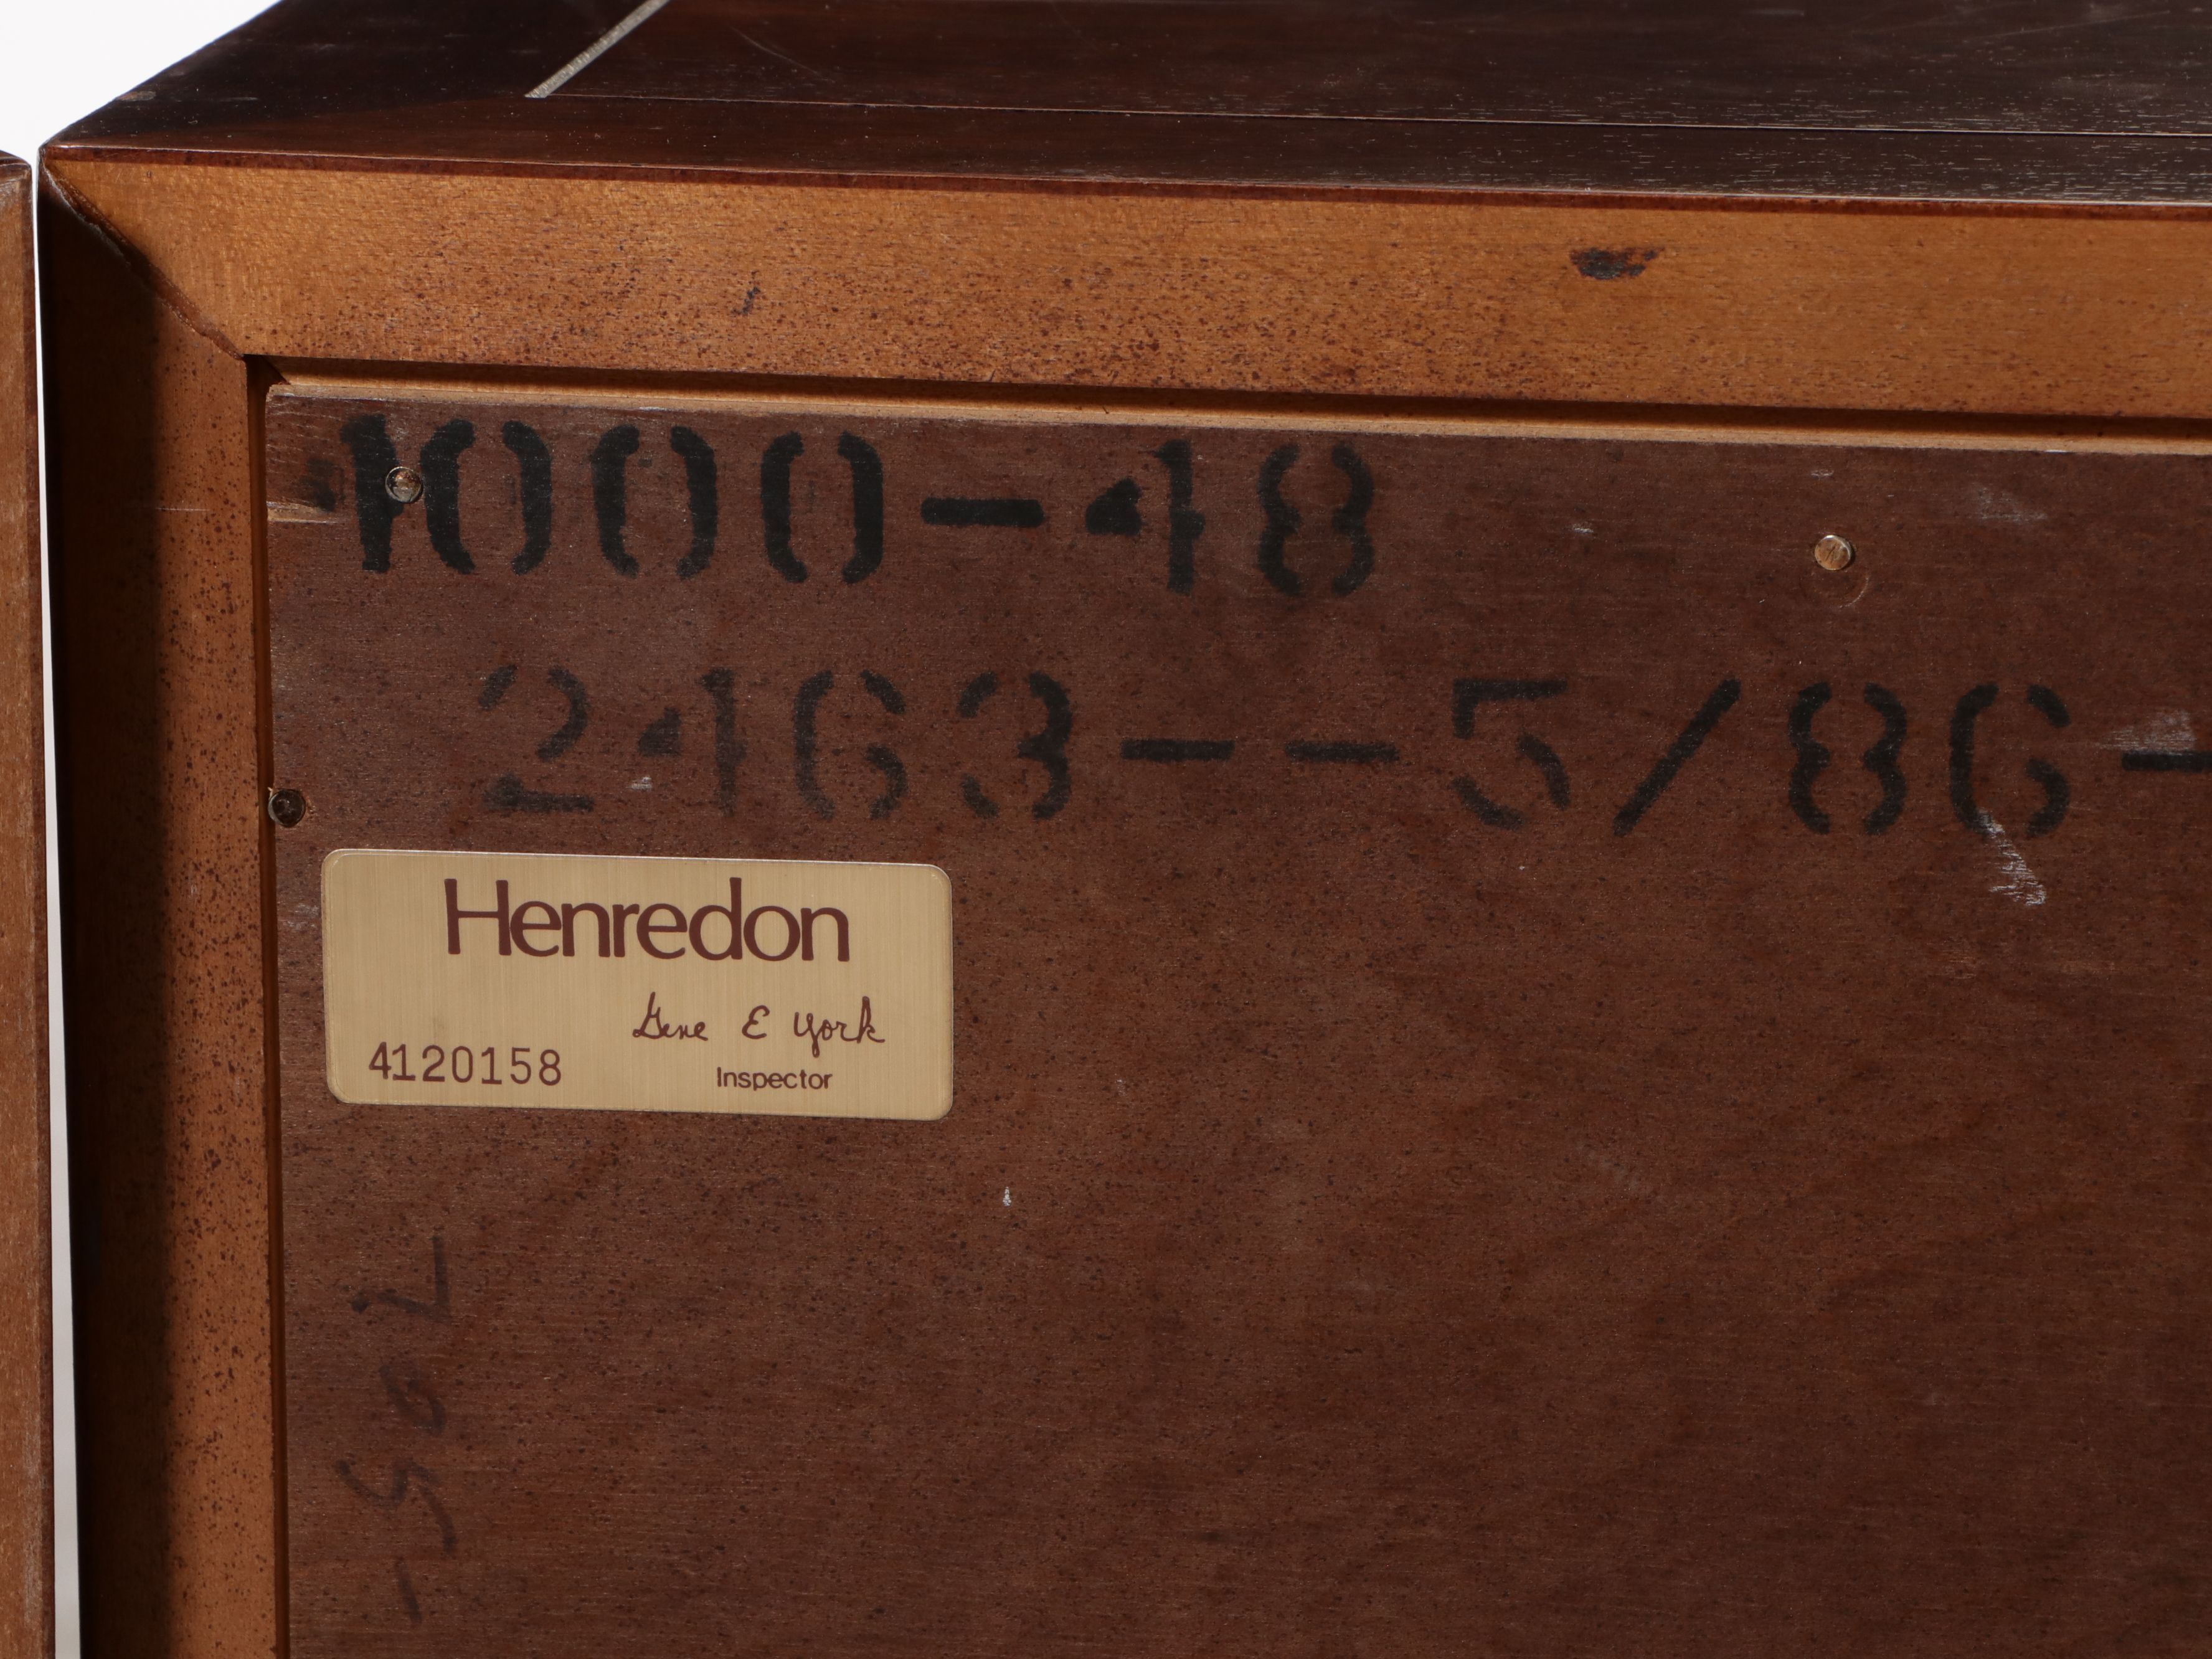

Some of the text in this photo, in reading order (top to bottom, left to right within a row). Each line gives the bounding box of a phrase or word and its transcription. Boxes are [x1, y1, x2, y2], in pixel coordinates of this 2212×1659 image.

[443, 877, 850, 962] Henredon
[631, 991, 709, 1041] Gene
[740, 1004, 770, 1040] E
[367, 1041, 562, 1087] 4120158
[716, 1067, 833, 1091] Inspector
